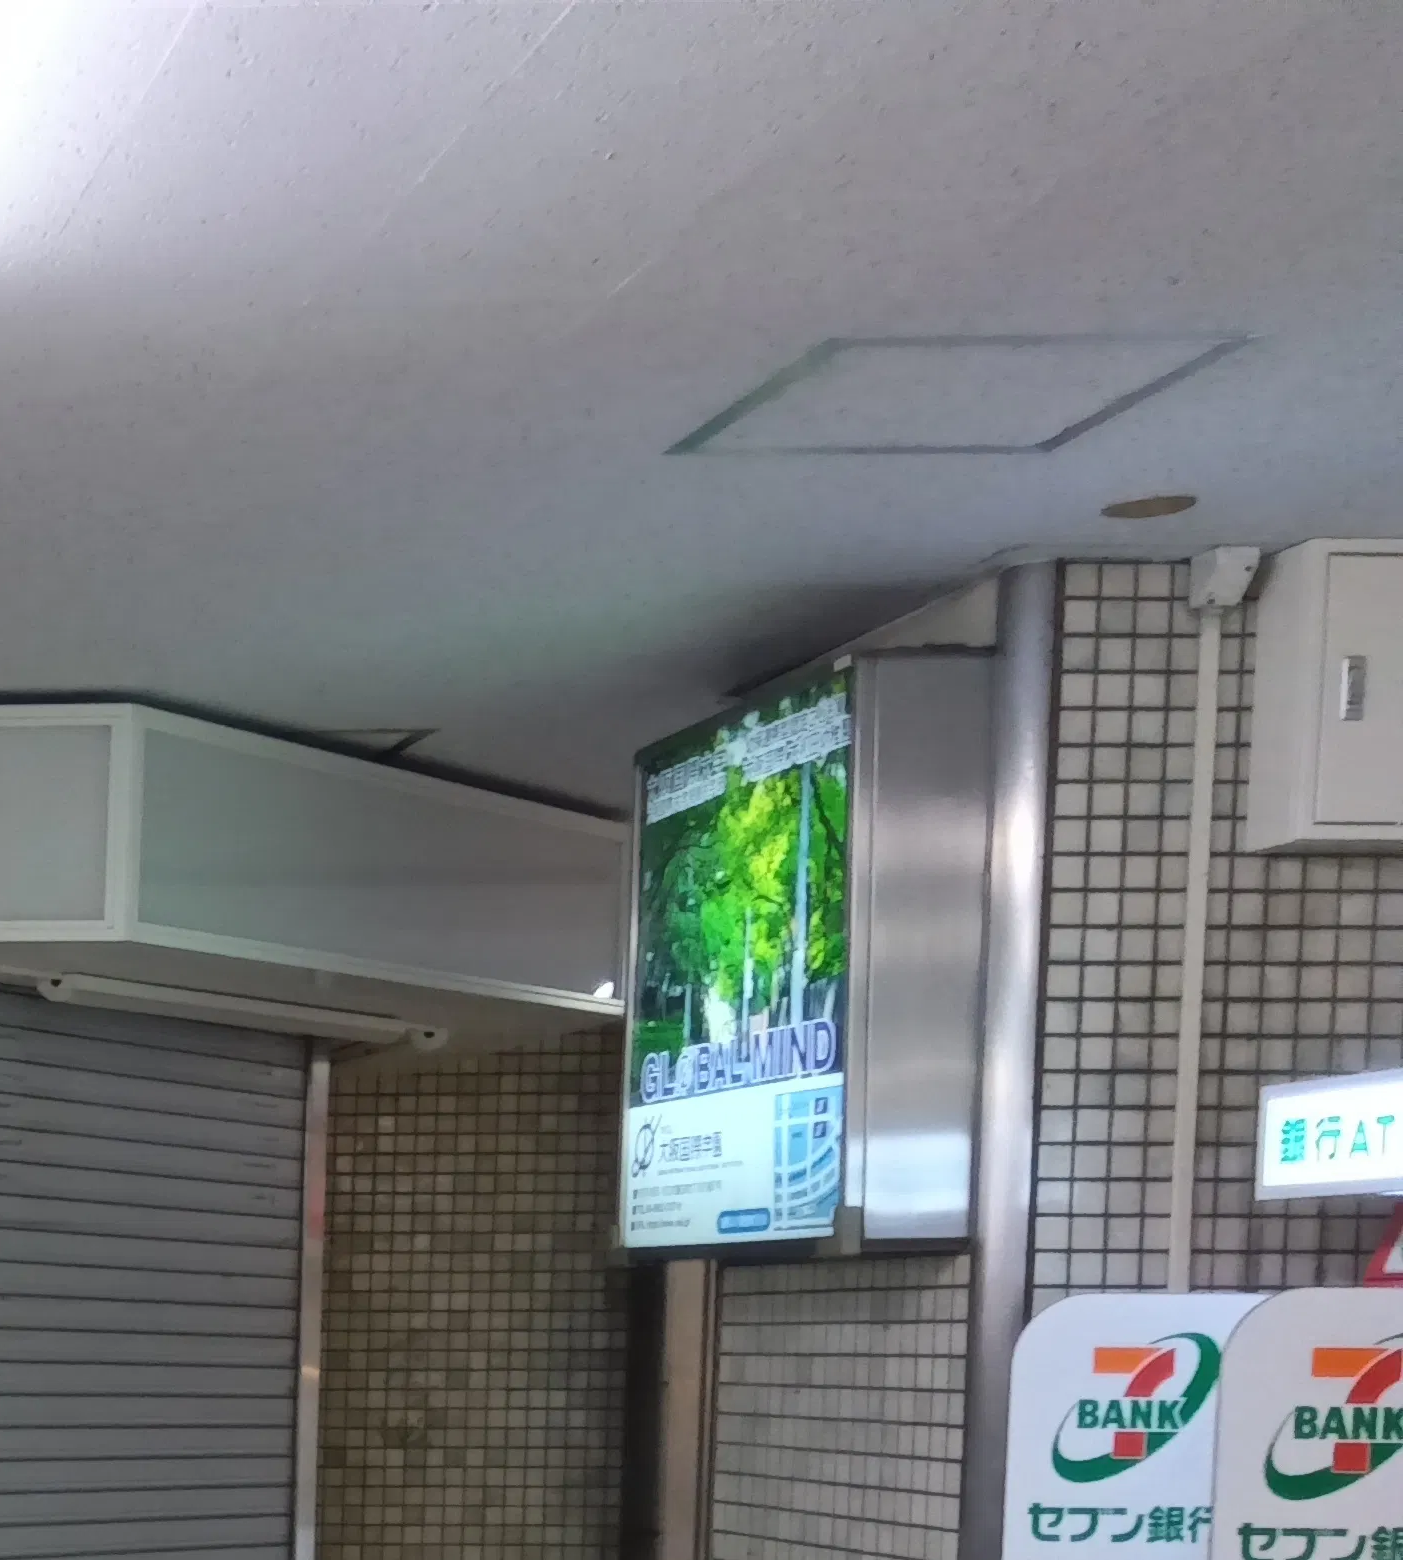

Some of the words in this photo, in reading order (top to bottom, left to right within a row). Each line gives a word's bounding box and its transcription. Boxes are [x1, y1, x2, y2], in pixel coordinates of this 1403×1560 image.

[640, 1037, 752, 1104] GLOBAL
[750, 1017, 837, 1085] MIND
[1077, 1399, 1181, 1430] BANK
[1294, 1405, 1403, 1441] BANK
